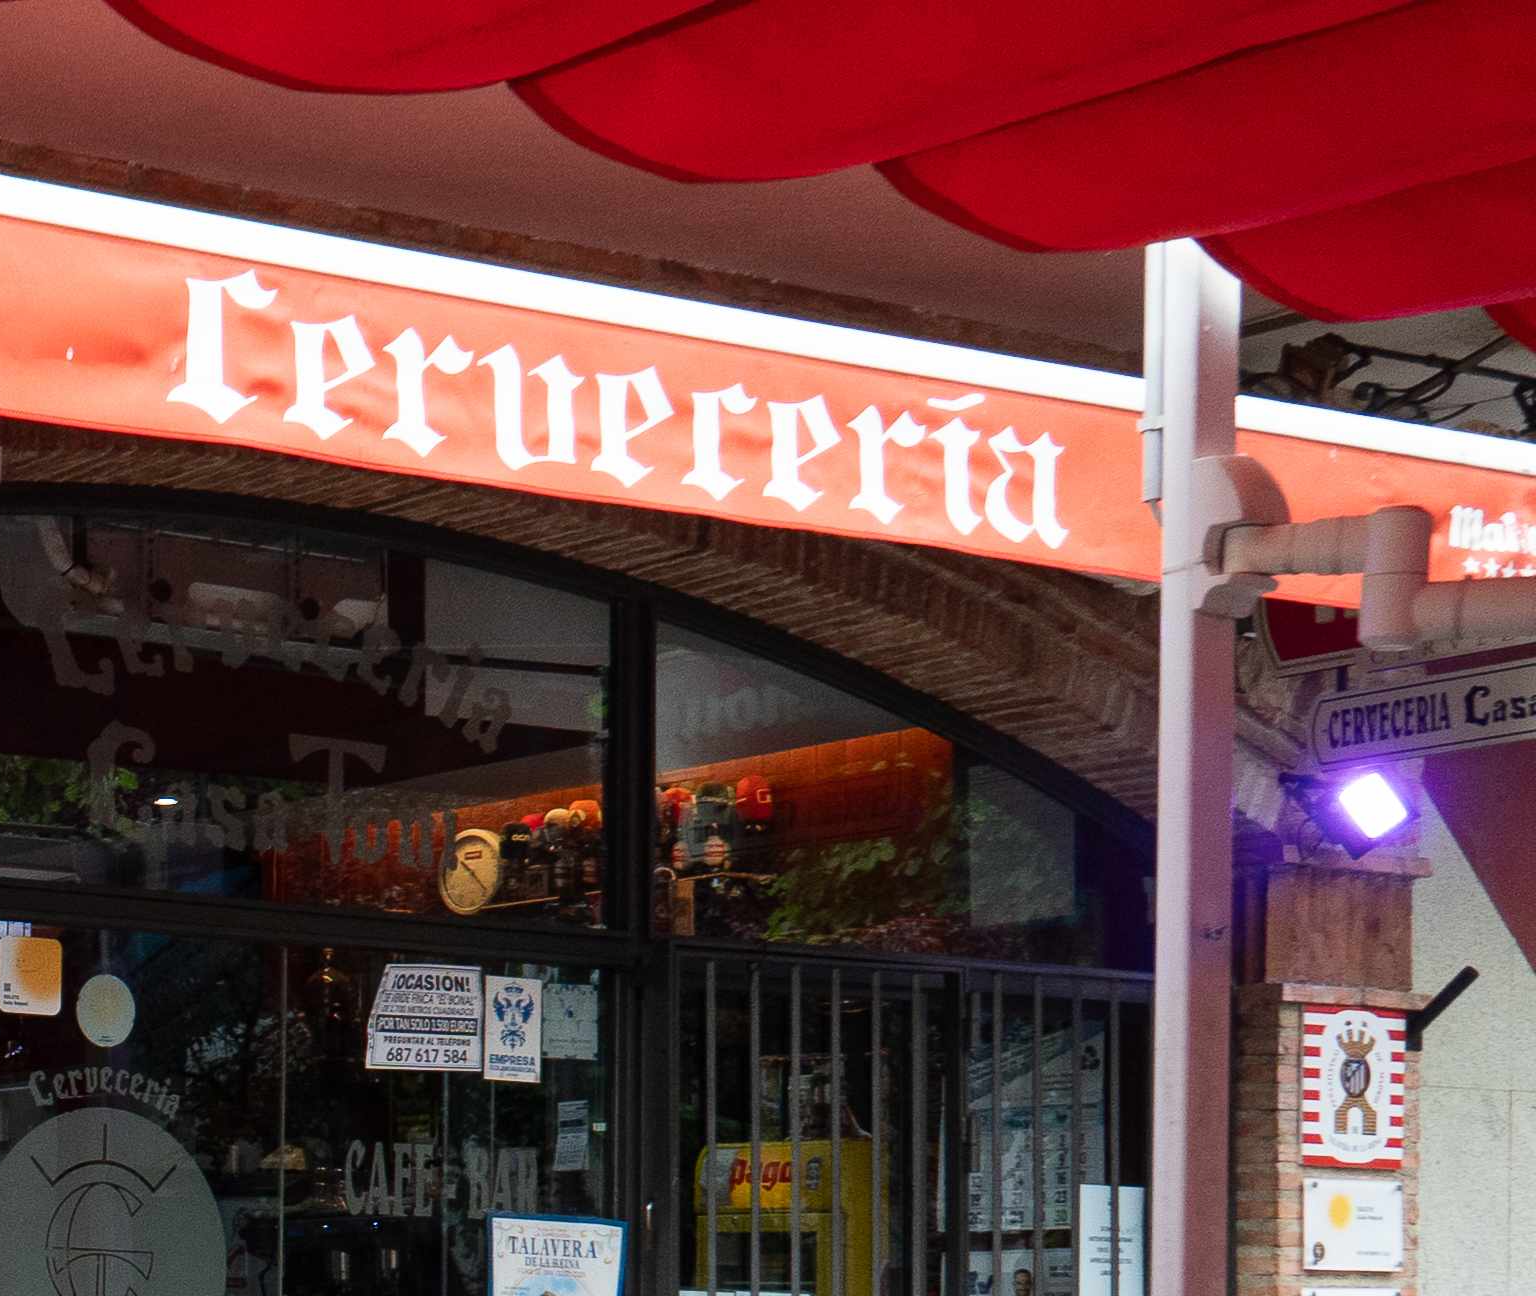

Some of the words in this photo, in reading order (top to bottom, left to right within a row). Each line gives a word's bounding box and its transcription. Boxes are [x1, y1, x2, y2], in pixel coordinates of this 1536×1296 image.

[166, 268, 1072, 549] Cervecería
[1328, 691, 1451, 748] CERVECERIA
[386, 1047, 411, 1063] 687
[415, 1048, 439, 1064] 617
[443, 1049, 468, 1064] 584
[508, 1235, 599, 1259] TALAVERA
